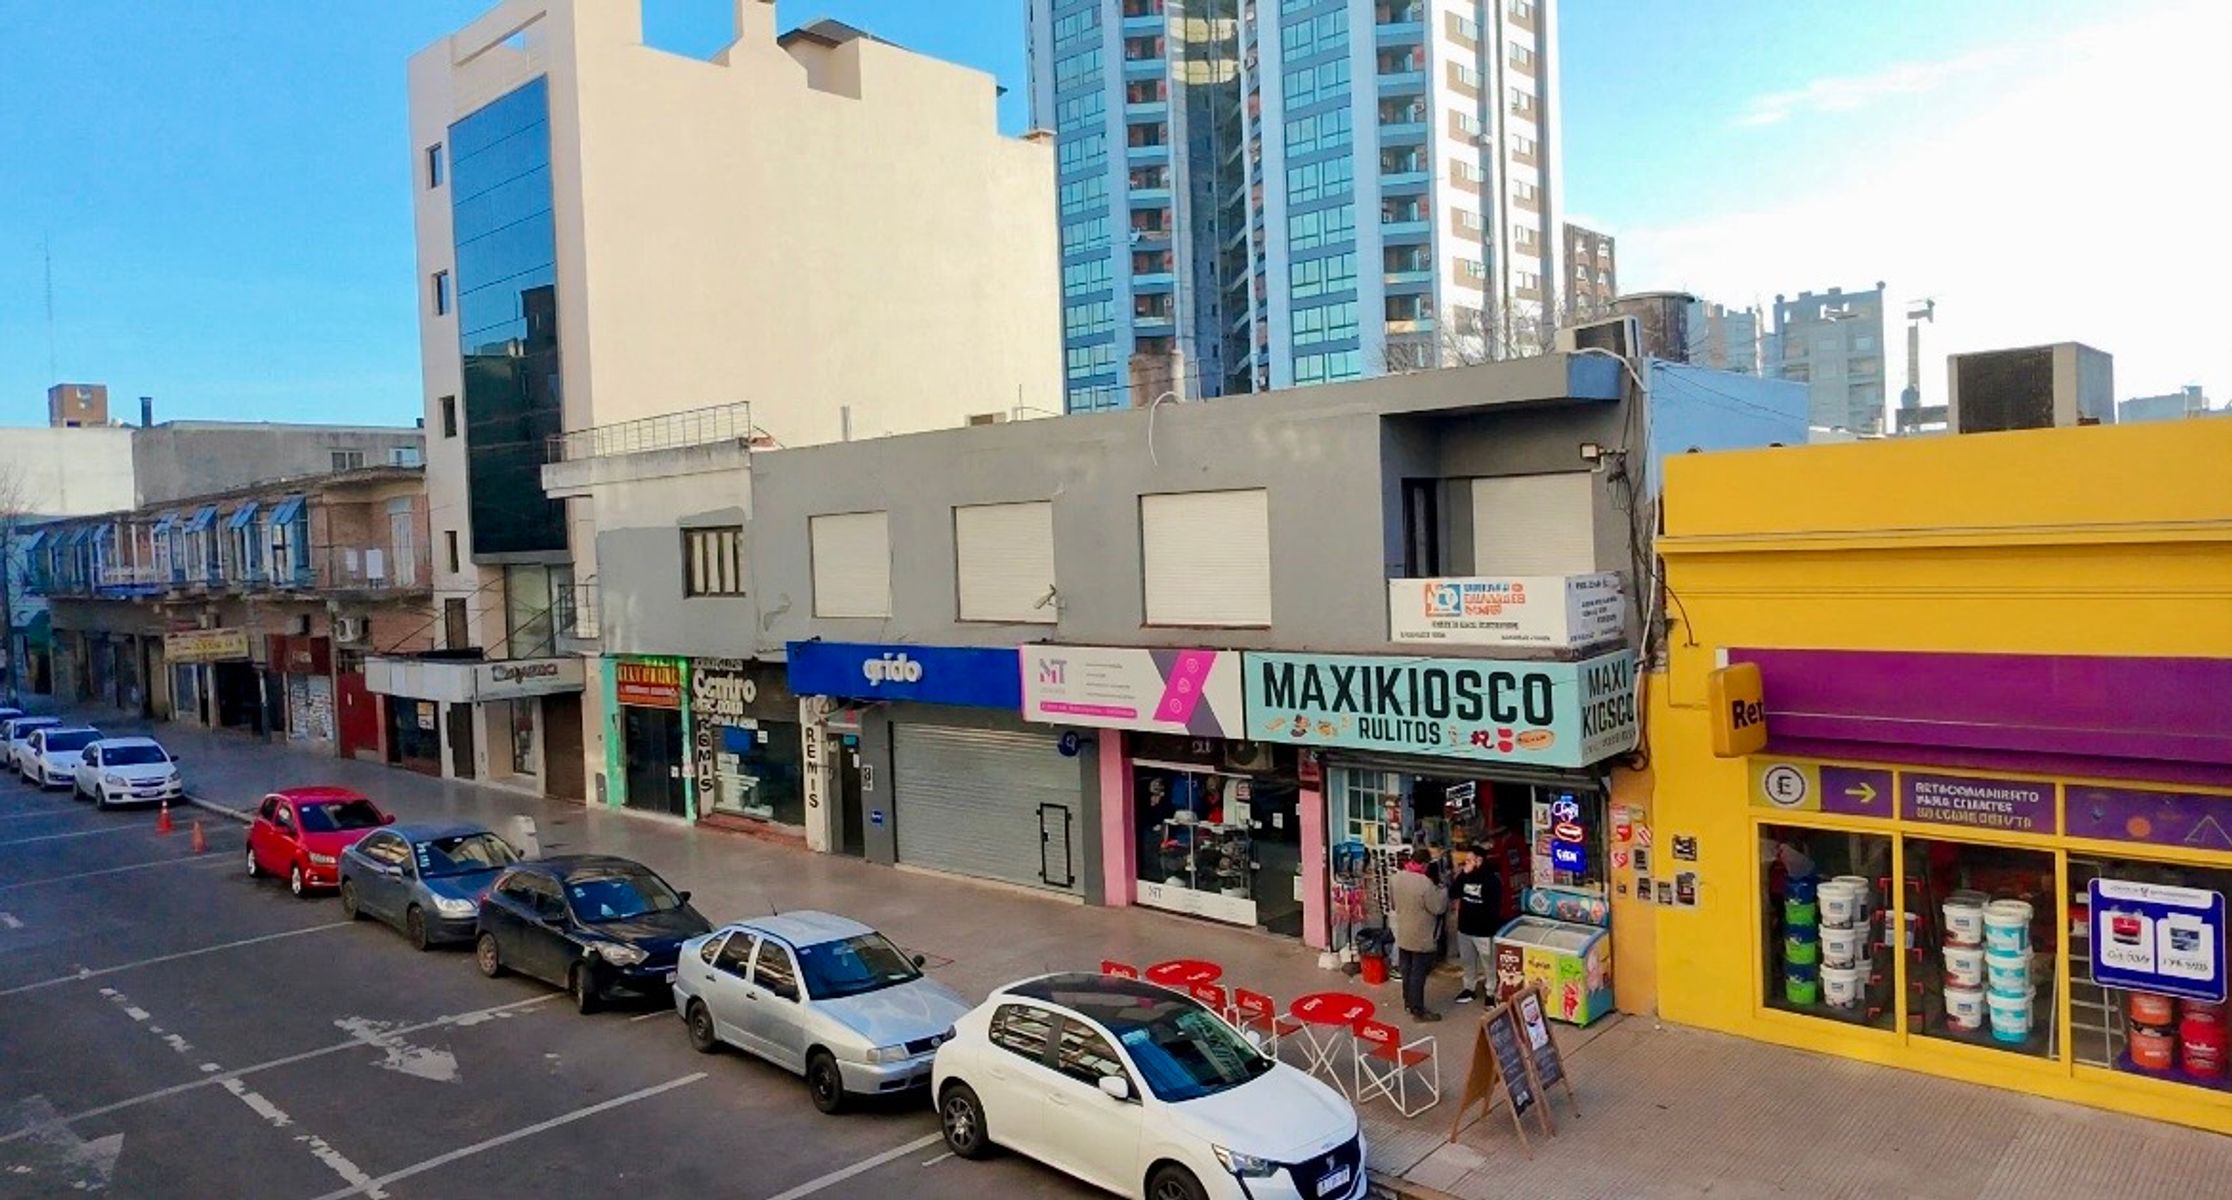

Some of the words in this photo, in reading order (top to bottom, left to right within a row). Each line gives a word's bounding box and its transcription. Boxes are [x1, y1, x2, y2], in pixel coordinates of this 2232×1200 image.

[1263, 662, 1554, 726] MAXIKIOSCO
[1588, 659, 1627, 699] MAXI
[1358, 717, 1441, 745] RULITOS
[1777, 776, 1793, 795] E
